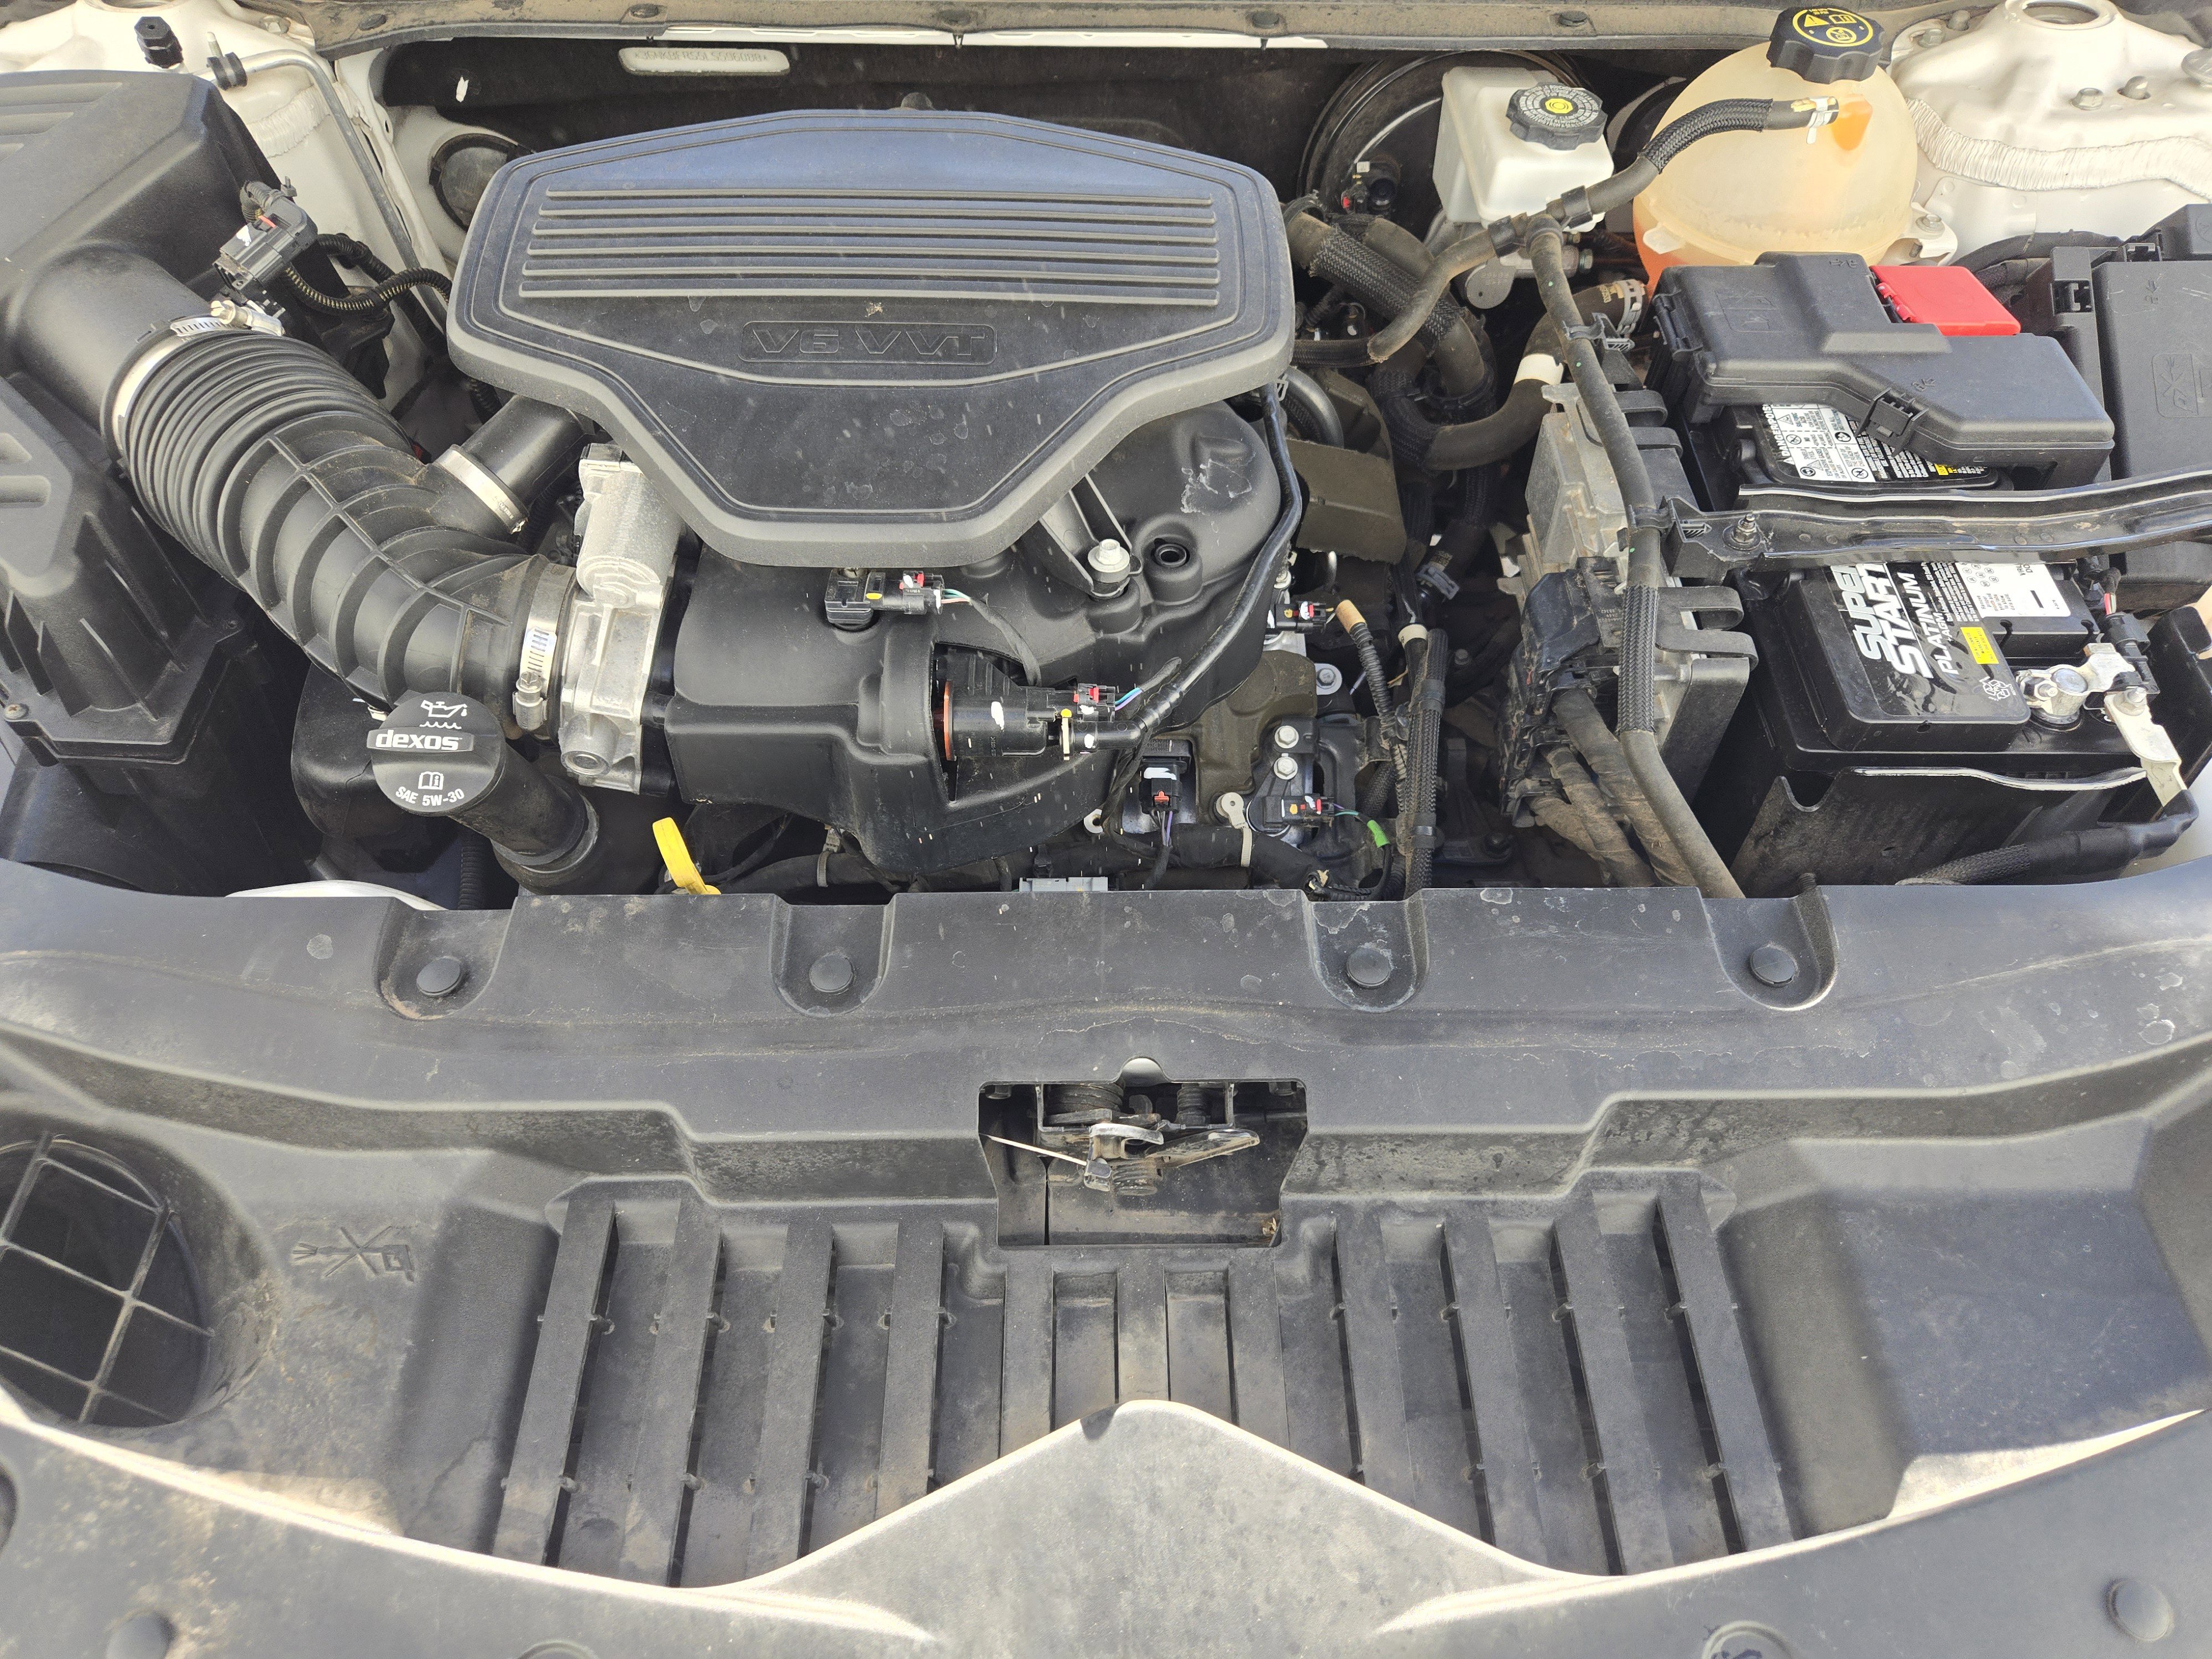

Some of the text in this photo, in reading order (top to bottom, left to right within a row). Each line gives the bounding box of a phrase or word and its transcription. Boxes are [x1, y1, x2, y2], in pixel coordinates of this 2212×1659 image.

[752, 328, 985, 356] V6 VVT
[1897, 572, 1959, 675] PLATINUM
[375, 729, 459, 750] dexos
[395, 786, 465, 806] SAE 5W-30
